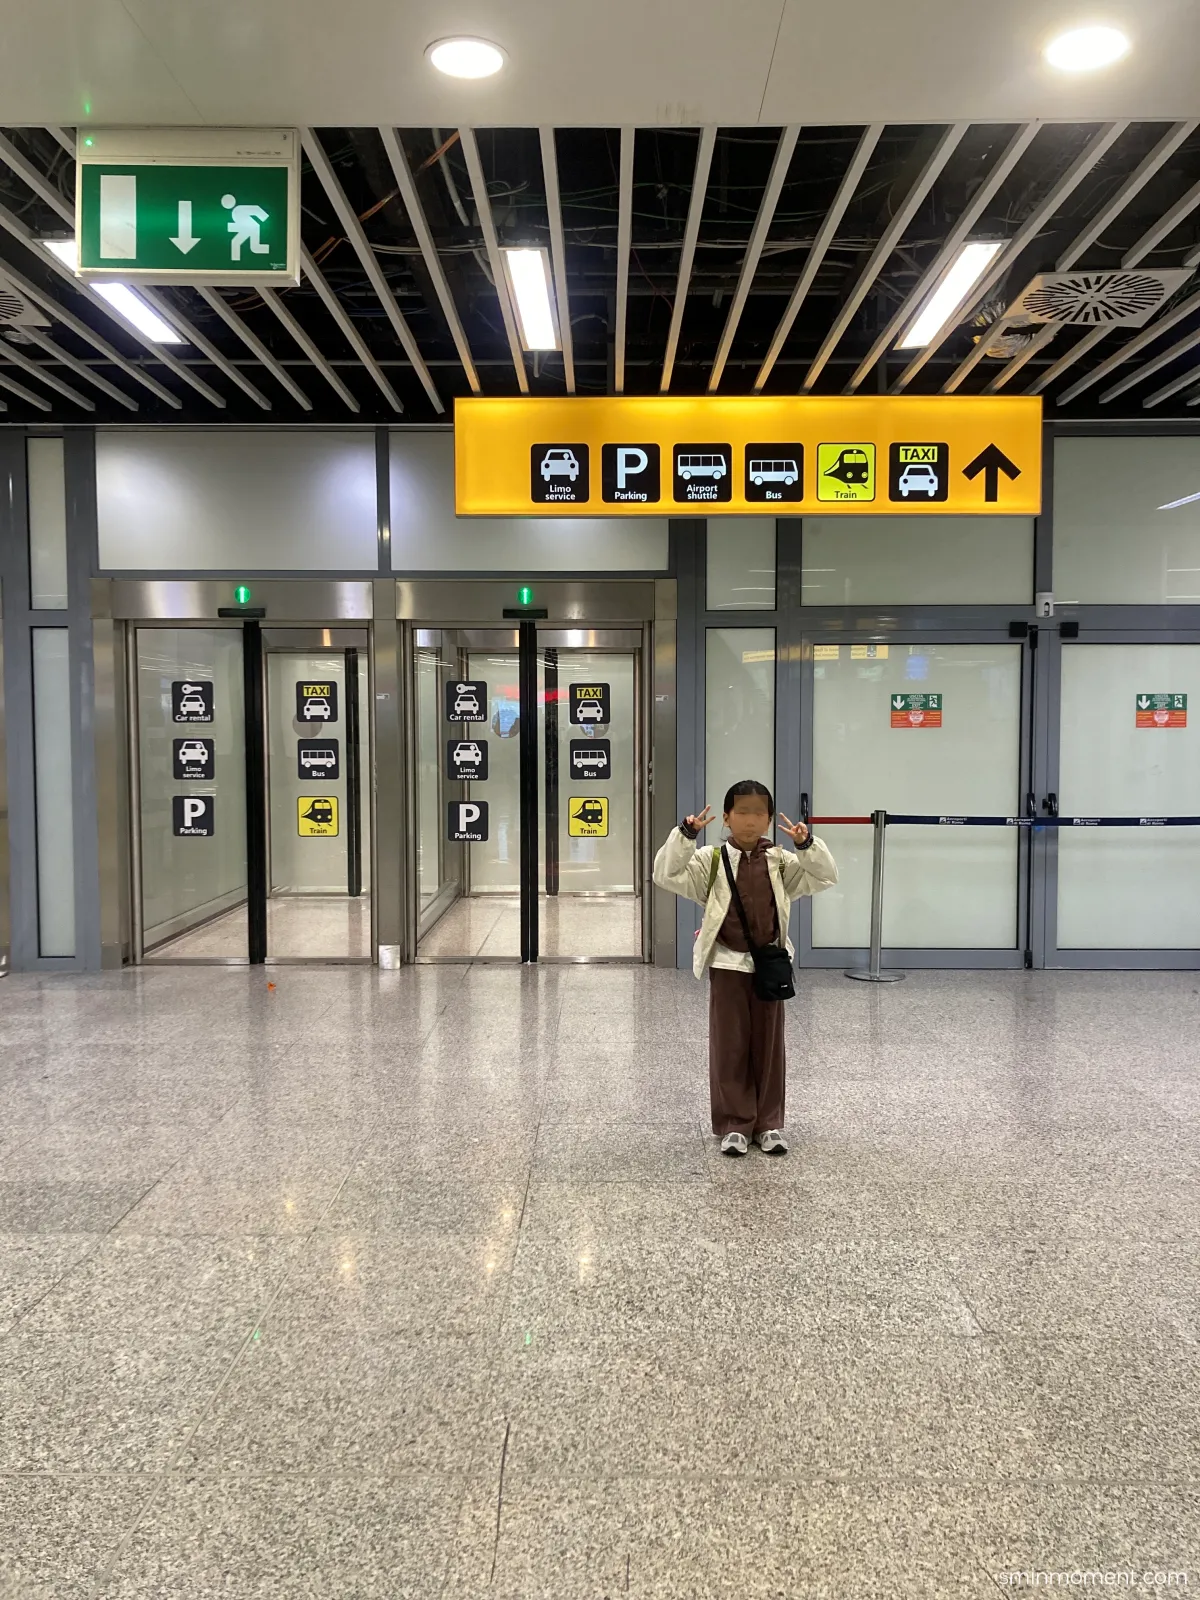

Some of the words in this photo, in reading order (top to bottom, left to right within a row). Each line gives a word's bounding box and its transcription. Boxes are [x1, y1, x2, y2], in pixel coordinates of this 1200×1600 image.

[902, 448, 936, 461] TAXI
[617, 447, 649, 489] P
[549, 484, 572, 493] Limo
[686, 484, 718, 495] Airport
[545, 492, 576, 501] service
[614, 491, 648, 502] Parking
[687, 491, 718, 500] shuttle
[765, 491, 782, 500] Bus
[834, 490, 857, 499] Train
[304, 686, 330, 696] TAXI
[577, 688, 602, 698] TAXI
[175, 714, 188, 722] Car
[189, 714, 211, 722] rental
[183, 798, 206, 827] P
[459, 803, 481, 832] P
[179, 827, 208, 836] Parking
[579, 827, 598, 835] Train
[454, 832, 482, 841] Parking
